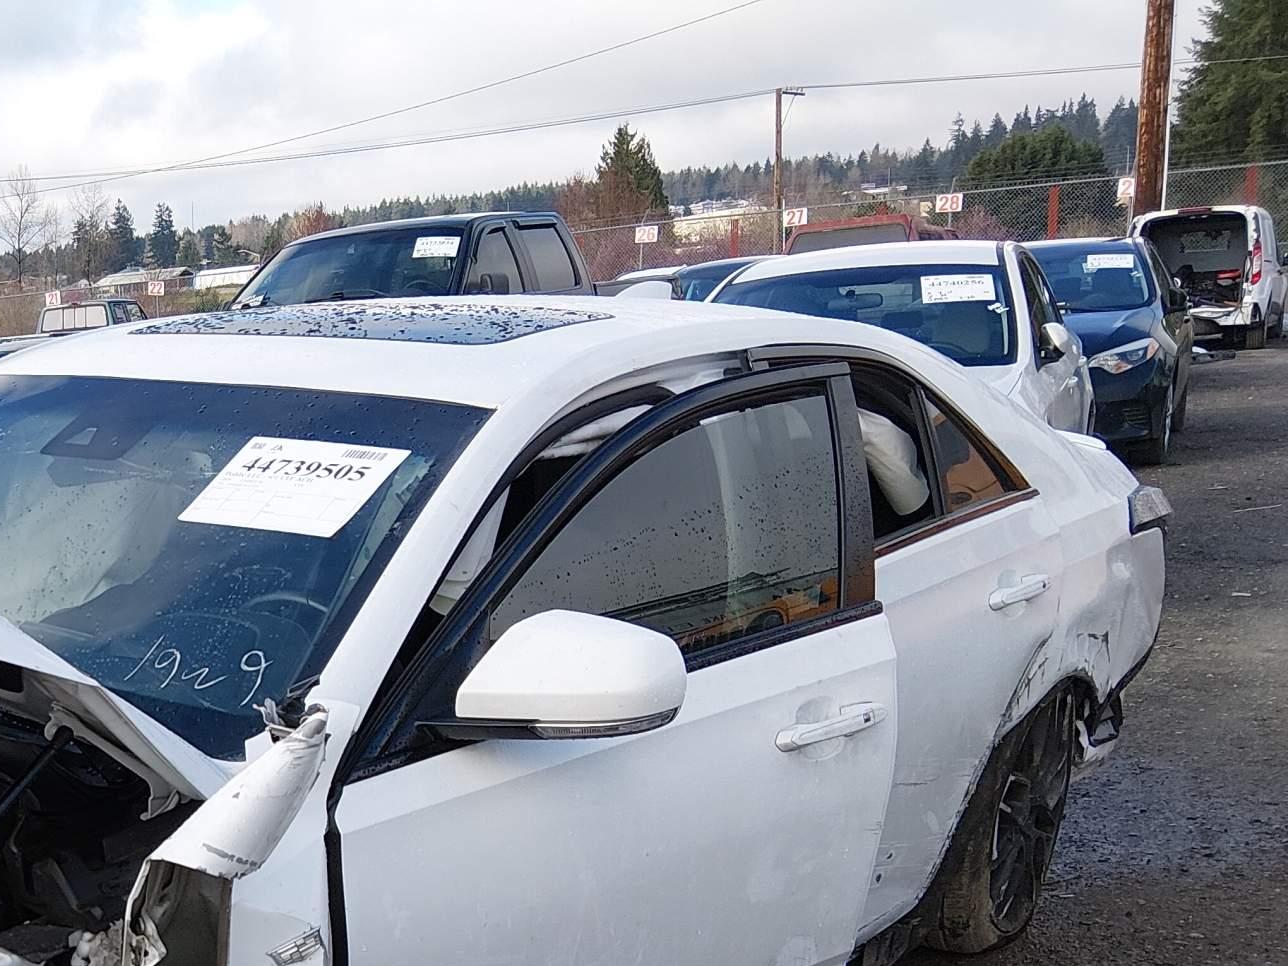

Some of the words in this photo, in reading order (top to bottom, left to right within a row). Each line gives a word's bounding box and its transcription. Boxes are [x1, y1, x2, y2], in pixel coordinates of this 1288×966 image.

[938, 195, 960, 211] 28
[786, 211, 804, 225] 27
[637, 227, 656, 241] 26
[150, 282, 163, 294] 22
[48, 292, 59, 305] 21
[242, 457, 372, 481] 44739505
